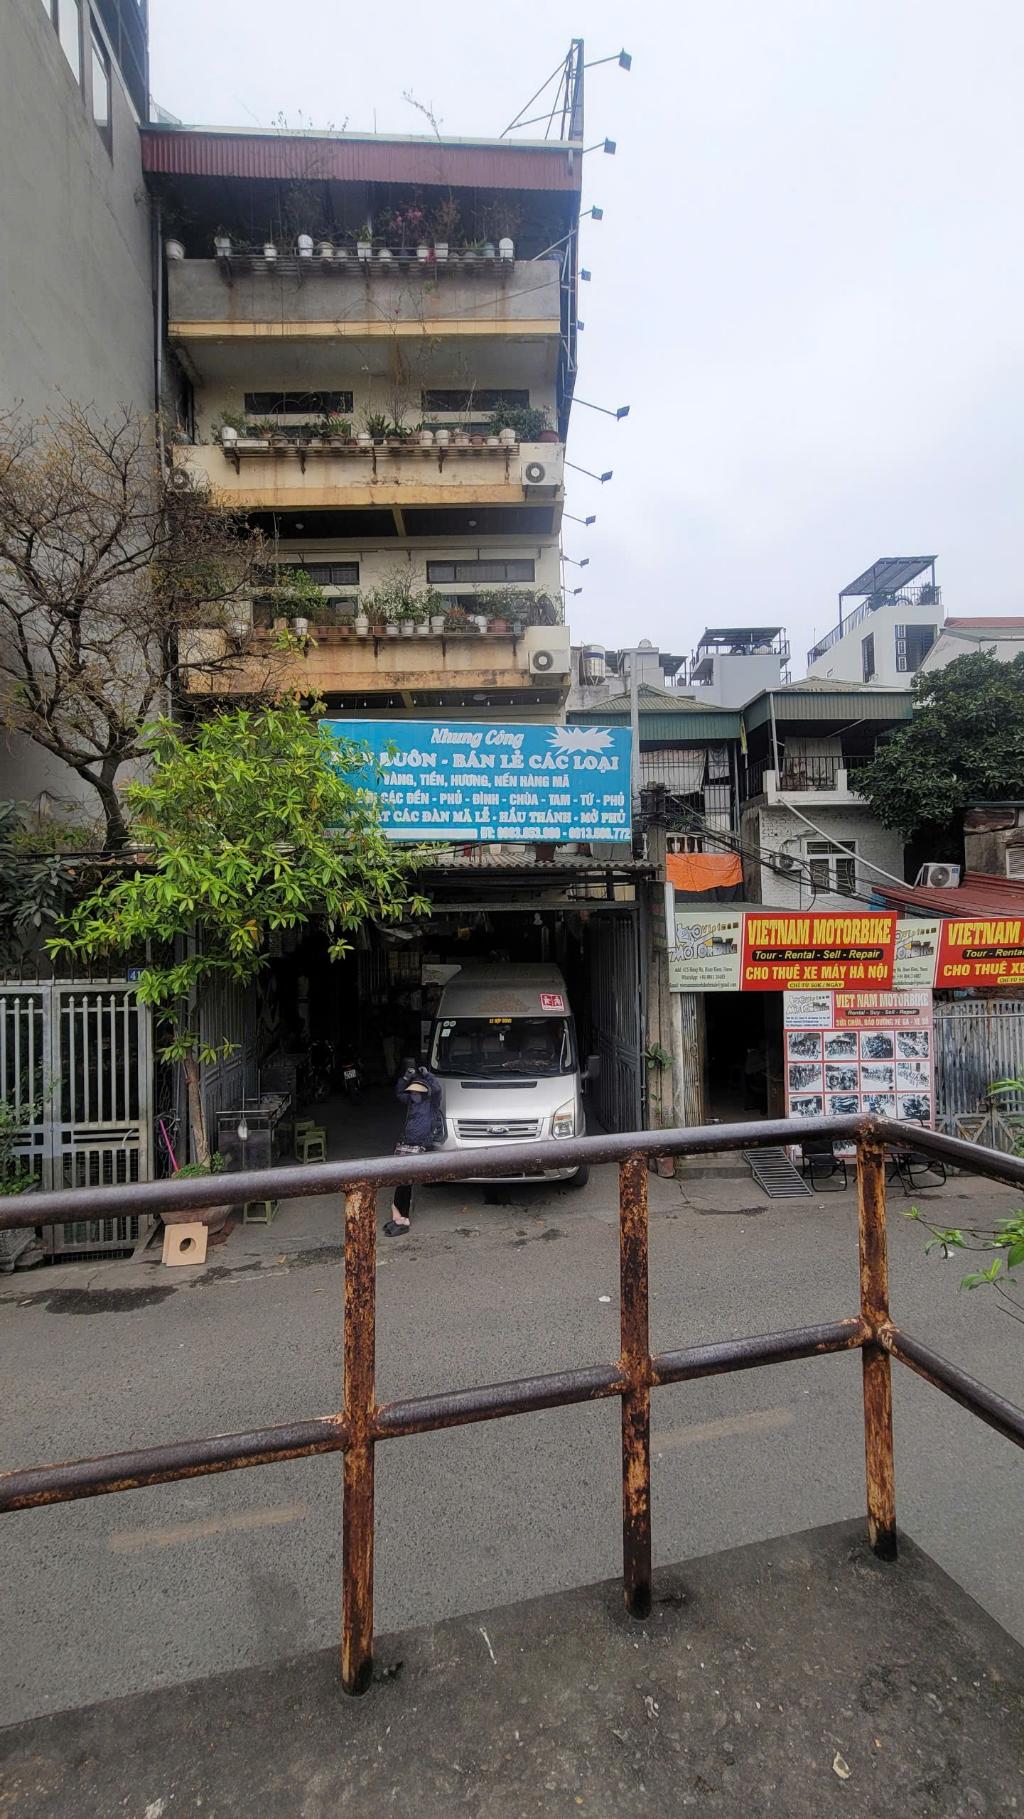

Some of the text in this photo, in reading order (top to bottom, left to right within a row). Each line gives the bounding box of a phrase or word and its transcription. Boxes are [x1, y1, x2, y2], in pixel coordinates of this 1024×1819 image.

[431, 728, 525, 749] Nhung Công
[452, 750, 496, 769] BÁN
[500, 749, 525, 769] LẺ
[528, 751, 569, 770] CÁC
[573, 755, 620, 774] LOẠI
[519, 773, 550, 788] HÀNG
[552, 773, 570, 788] MÃ
[439, 788, 463, 805] PHỦ
[509, 791, 539, 806] CHÙA
[602, 791, 625, 807] PHỦ
[392, 807, 420, 823] CÁC
[747, 919, 810, 946] VIETNAM
[812, 918, 893, 944] MOTORBIKE
[948, 922, 1021, 946] VIETNAM
[755, 950, 777, 960] Tour
[784, 950, 816, 960] Rental
[823, 949, 841, 959] Sell
[848, 949, 881, 961] Repair
[965, 949, 988, 958] Tour
[745, 967, 769, 980] CHO
[771, 964, 801, 980] THUÊ
[803, 965, 818, 980] XE
[821, 964, 848, 980] MÁY
[849, 963, 865, 979] HÀ
[867, 963, 889, 982] NỘI
[943, 964, 970, 977] CHO
[974, 961, 1007, 976] THUÊ
[856, 993, 878, 1007] NAM
[880, 992, 929, 1007] MOTORBIKE
